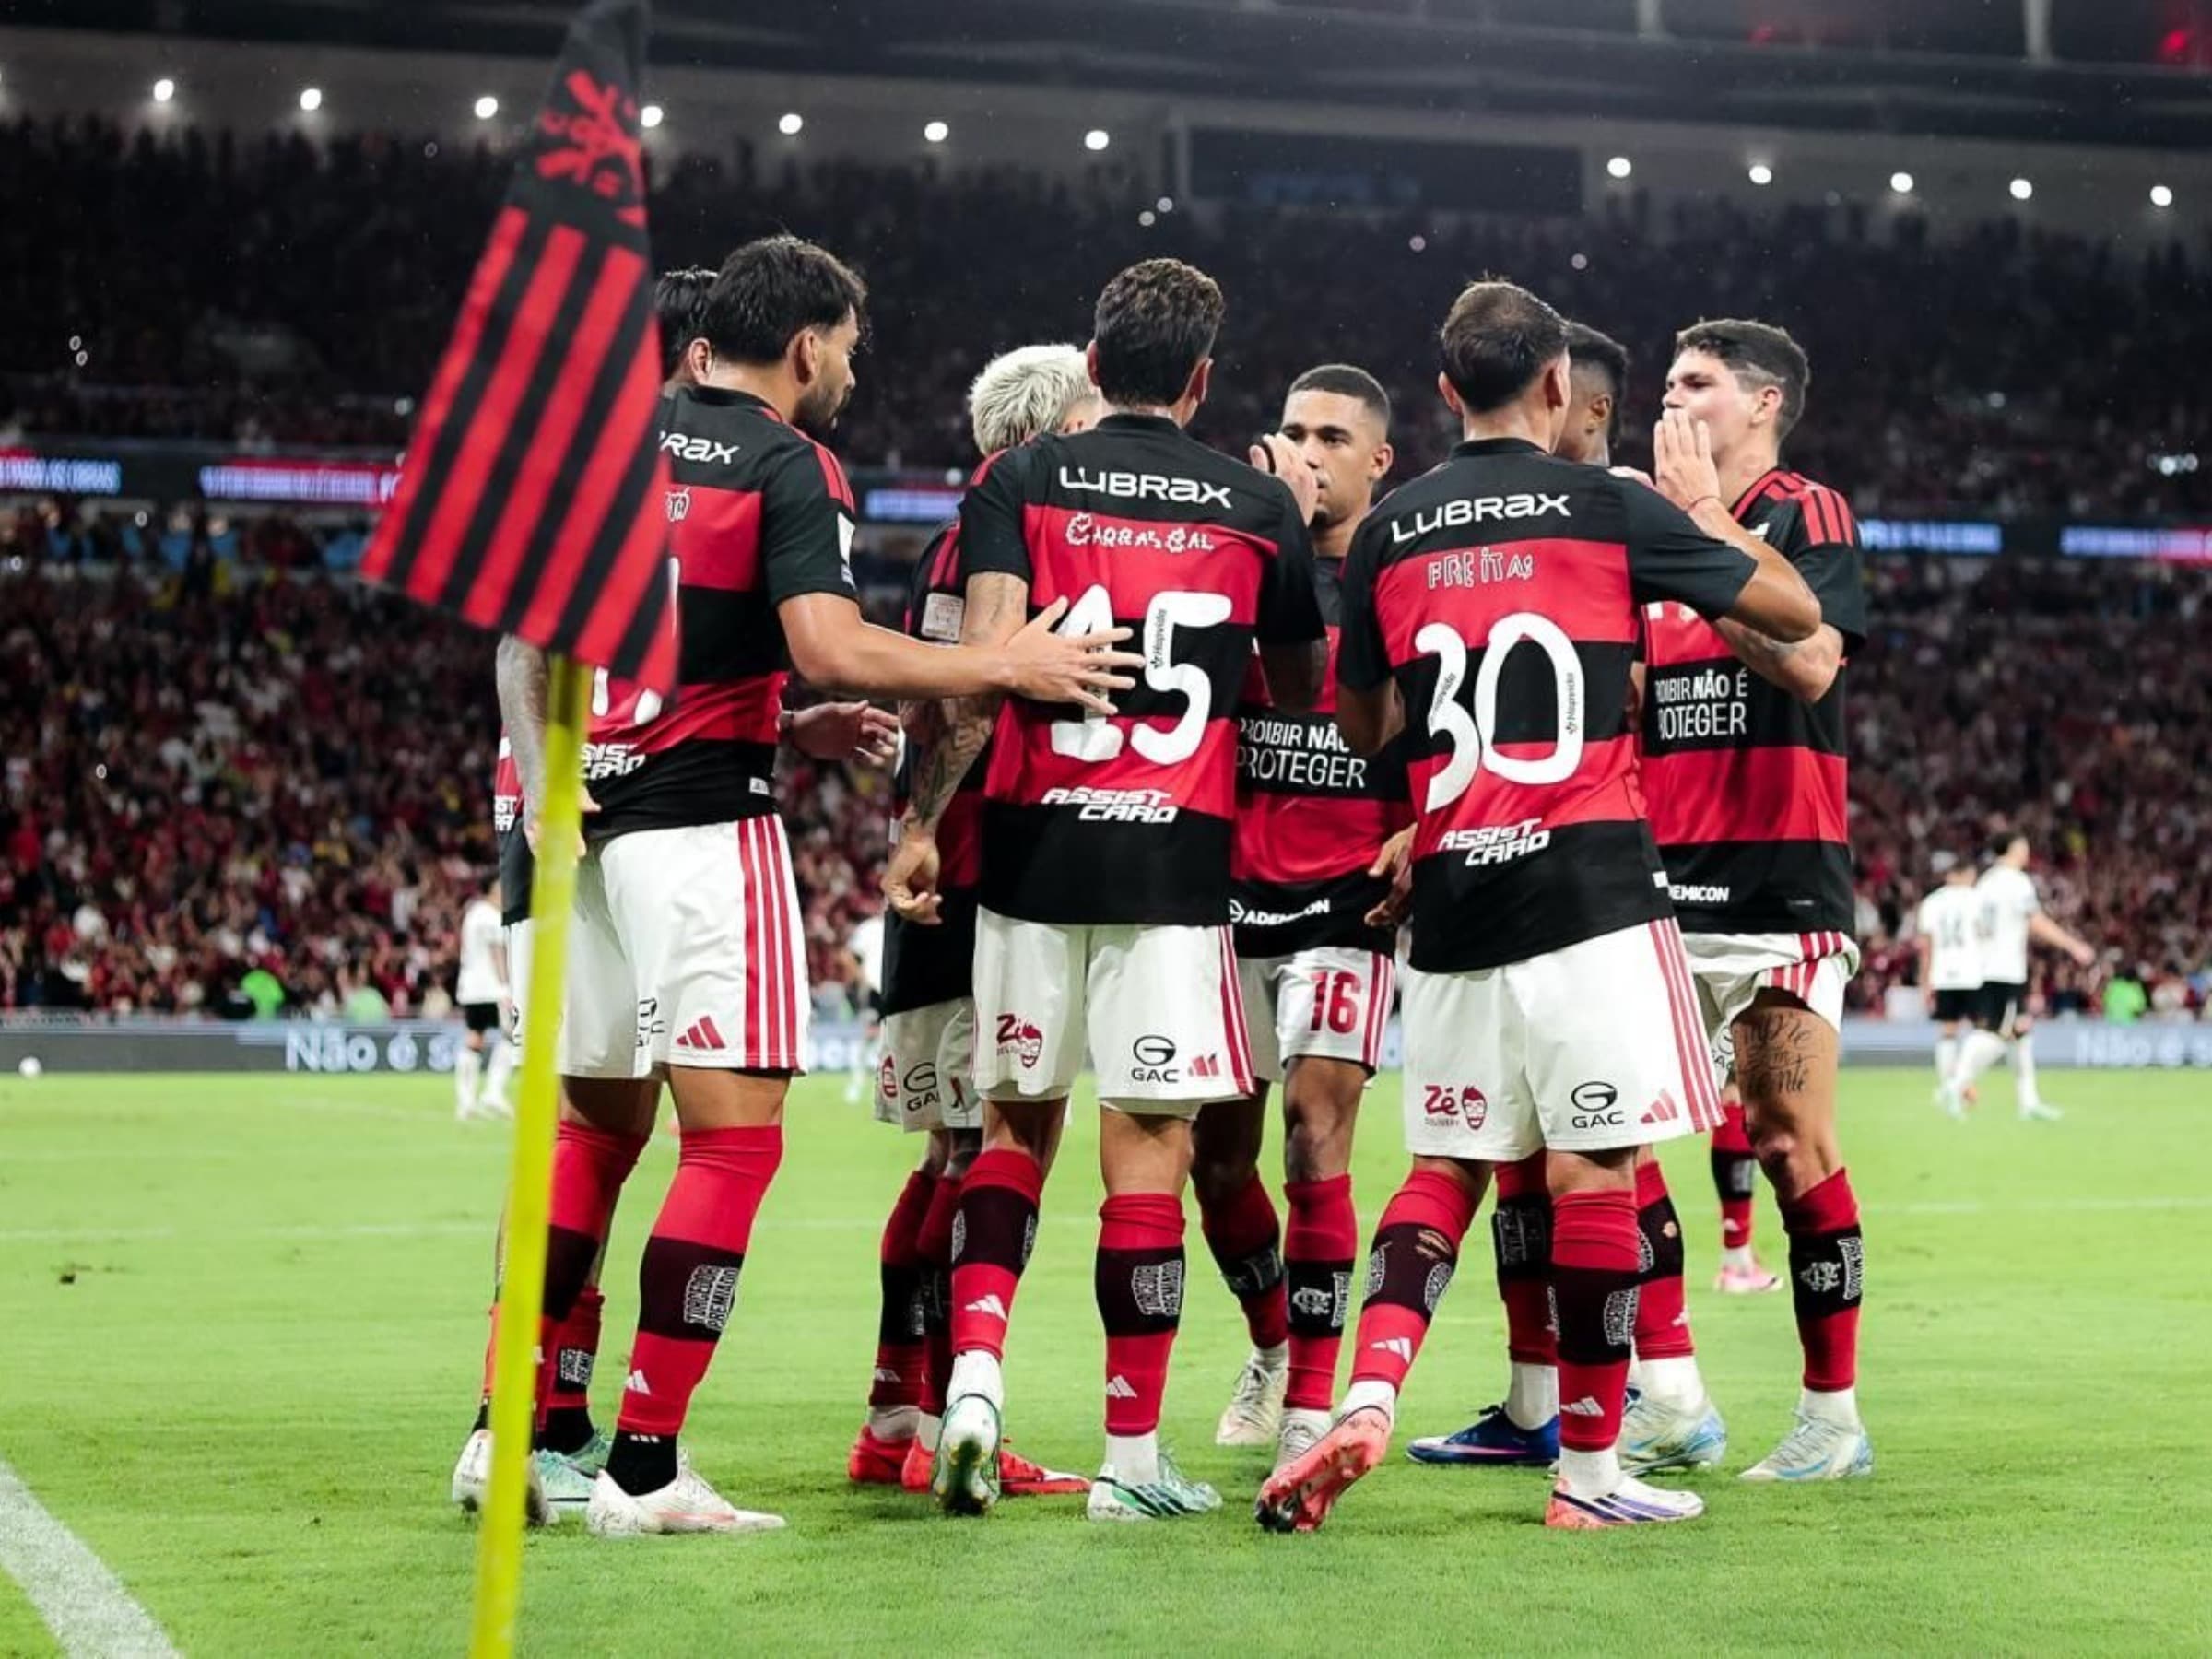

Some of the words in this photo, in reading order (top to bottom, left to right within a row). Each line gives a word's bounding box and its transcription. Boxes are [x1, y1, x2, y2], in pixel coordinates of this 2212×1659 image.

[1415, 612, 1585, 814] 30
[1041, 786, 1172, 807] ASSIST
[1078, 804, 1179, 823] CARD
[1436, 818, 1542, 852] ASSIST
[1465, 830, 1550, 866] CARD
[1310, 971, 1361, 1034] 16
[1131, 1067, 1180, 1084] GAC
[1425, 1085, 1460, 1117] Zé
[1571, 1110, 1625, 1130] GAC
